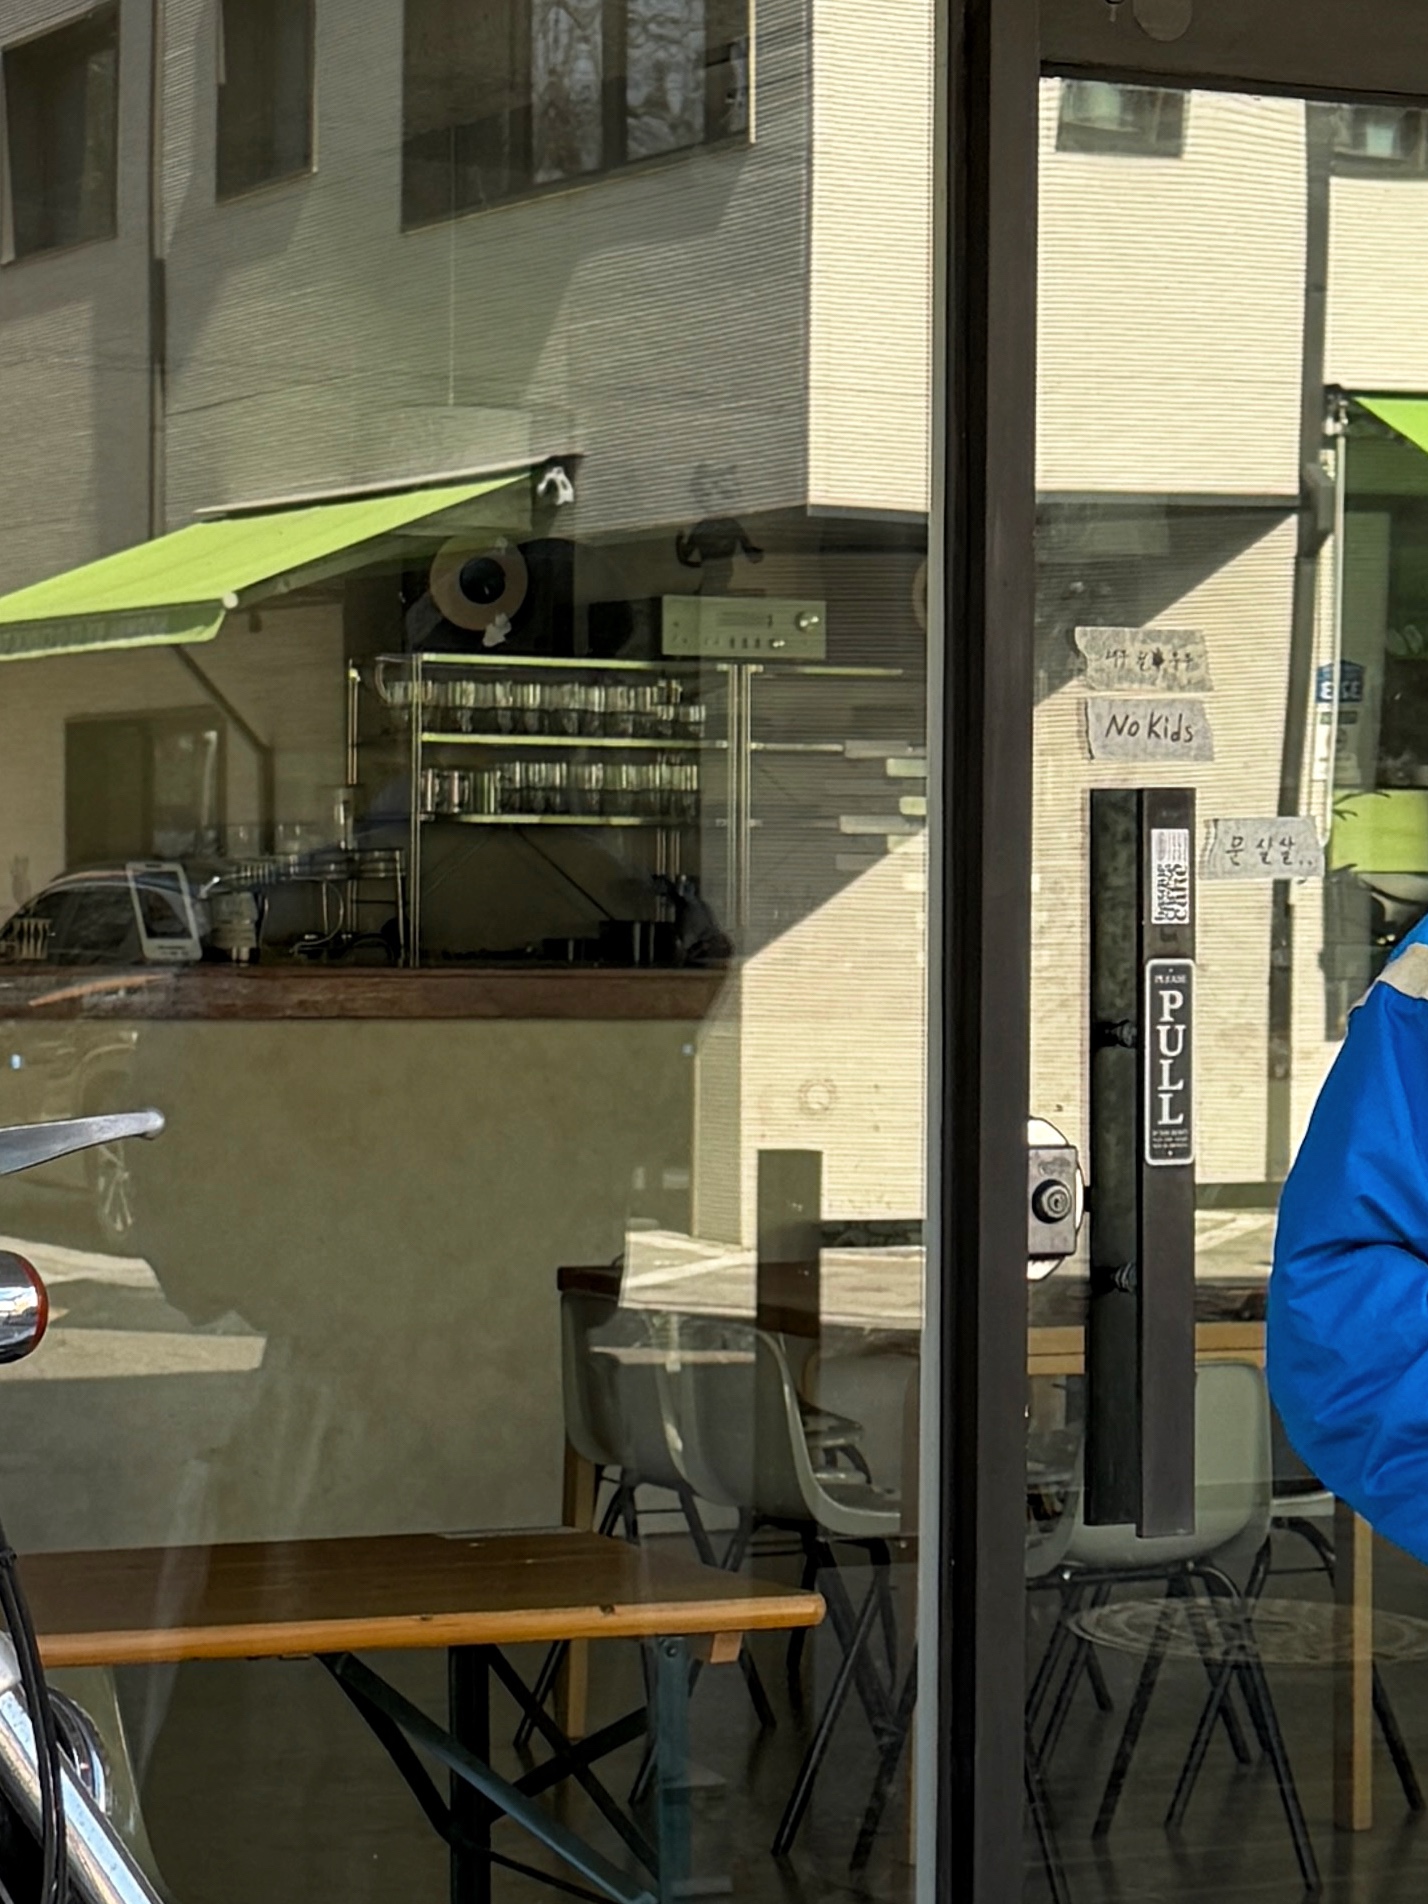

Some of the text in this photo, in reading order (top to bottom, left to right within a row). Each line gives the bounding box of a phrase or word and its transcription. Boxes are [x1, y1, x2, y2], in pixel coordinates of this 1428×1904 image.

[1105, 711, 1194, 743] No Kids
[1225, 835, 1244, 867] 문
[1157, 988, 1188, 1126] PULL
